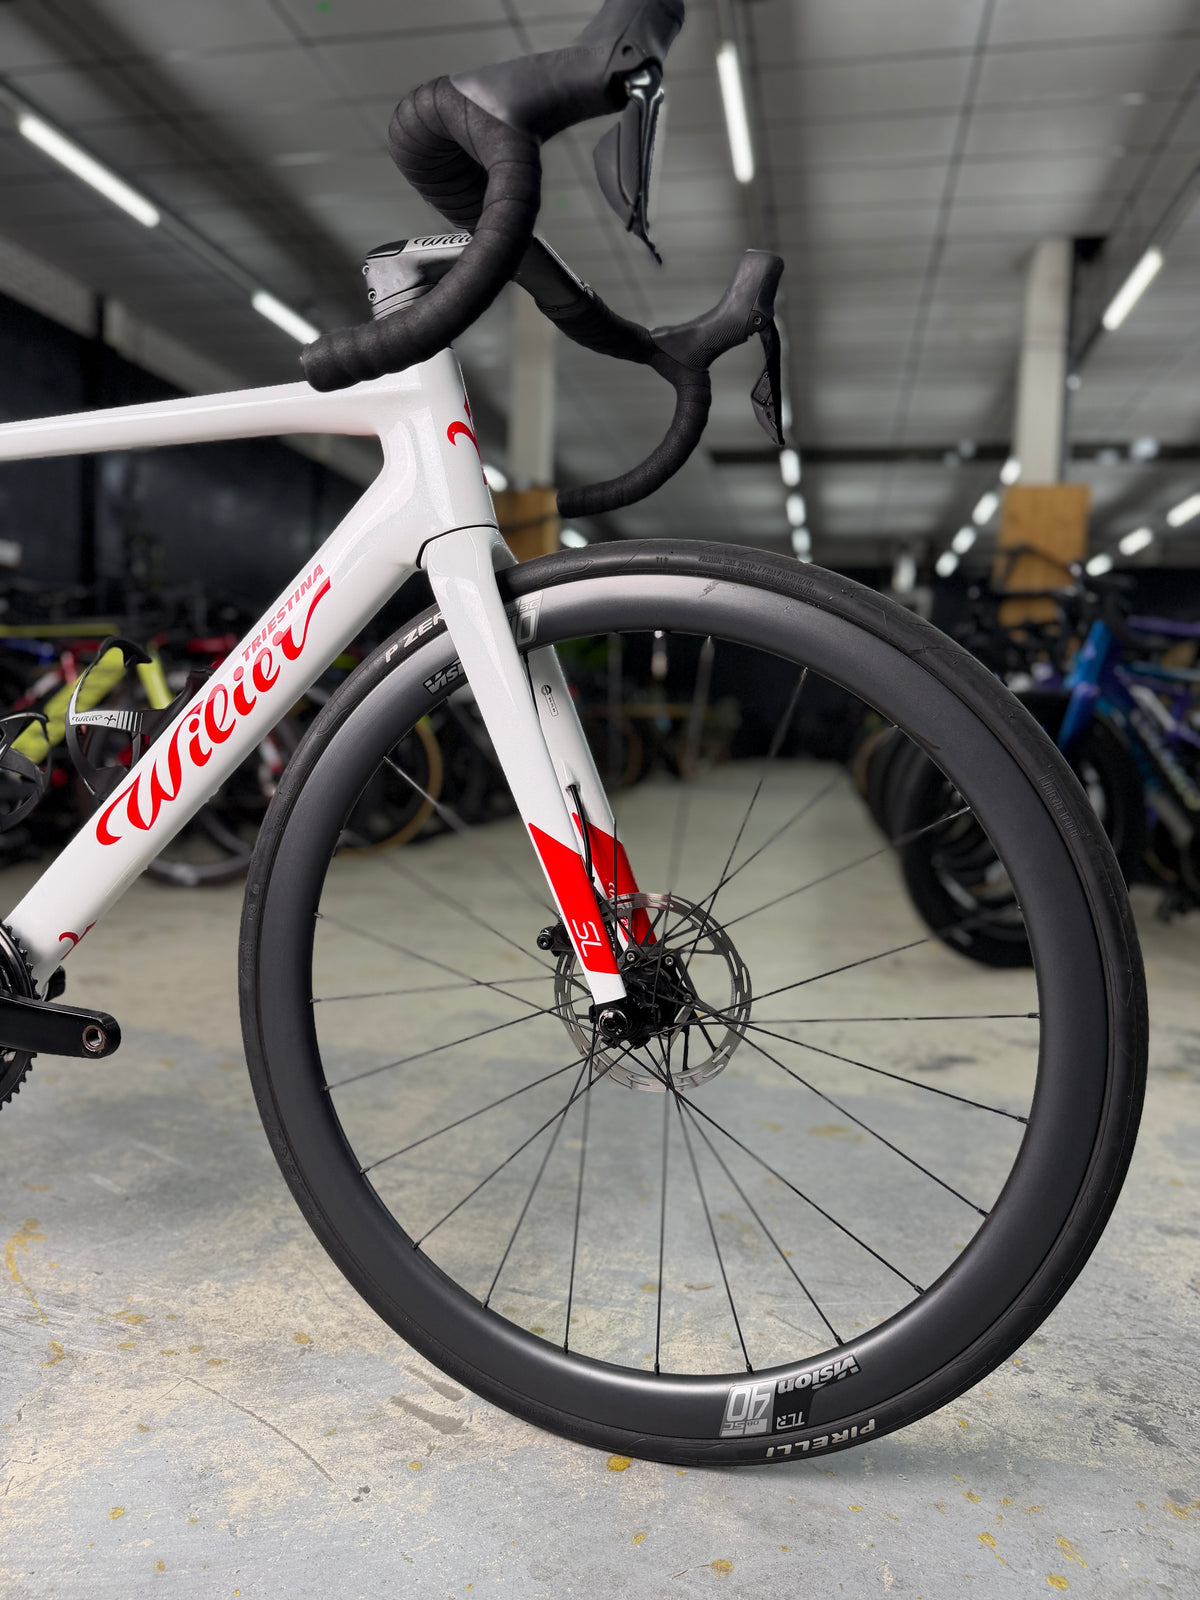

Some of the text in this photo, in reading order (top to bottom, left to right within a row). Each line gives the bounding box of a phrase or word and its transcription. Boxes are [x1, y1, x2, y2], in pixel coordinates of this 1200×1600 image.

[242, 563, 324, 662] TRIESTINA
[509, 609, 537, 645] 0
[385, 611, 445, 663] P ZER
[424, 659, 465, 694] Visi
[96, 576, 331, 846] Wilier
[571, 919, 602, 958] SL
[777, 1354, 861, 1395] Vision
[727, 1385, 771, 1422] 40
[775, 1411, 806, 1430] TLR
[765, 1418, 876, 1458] PIRELLI
